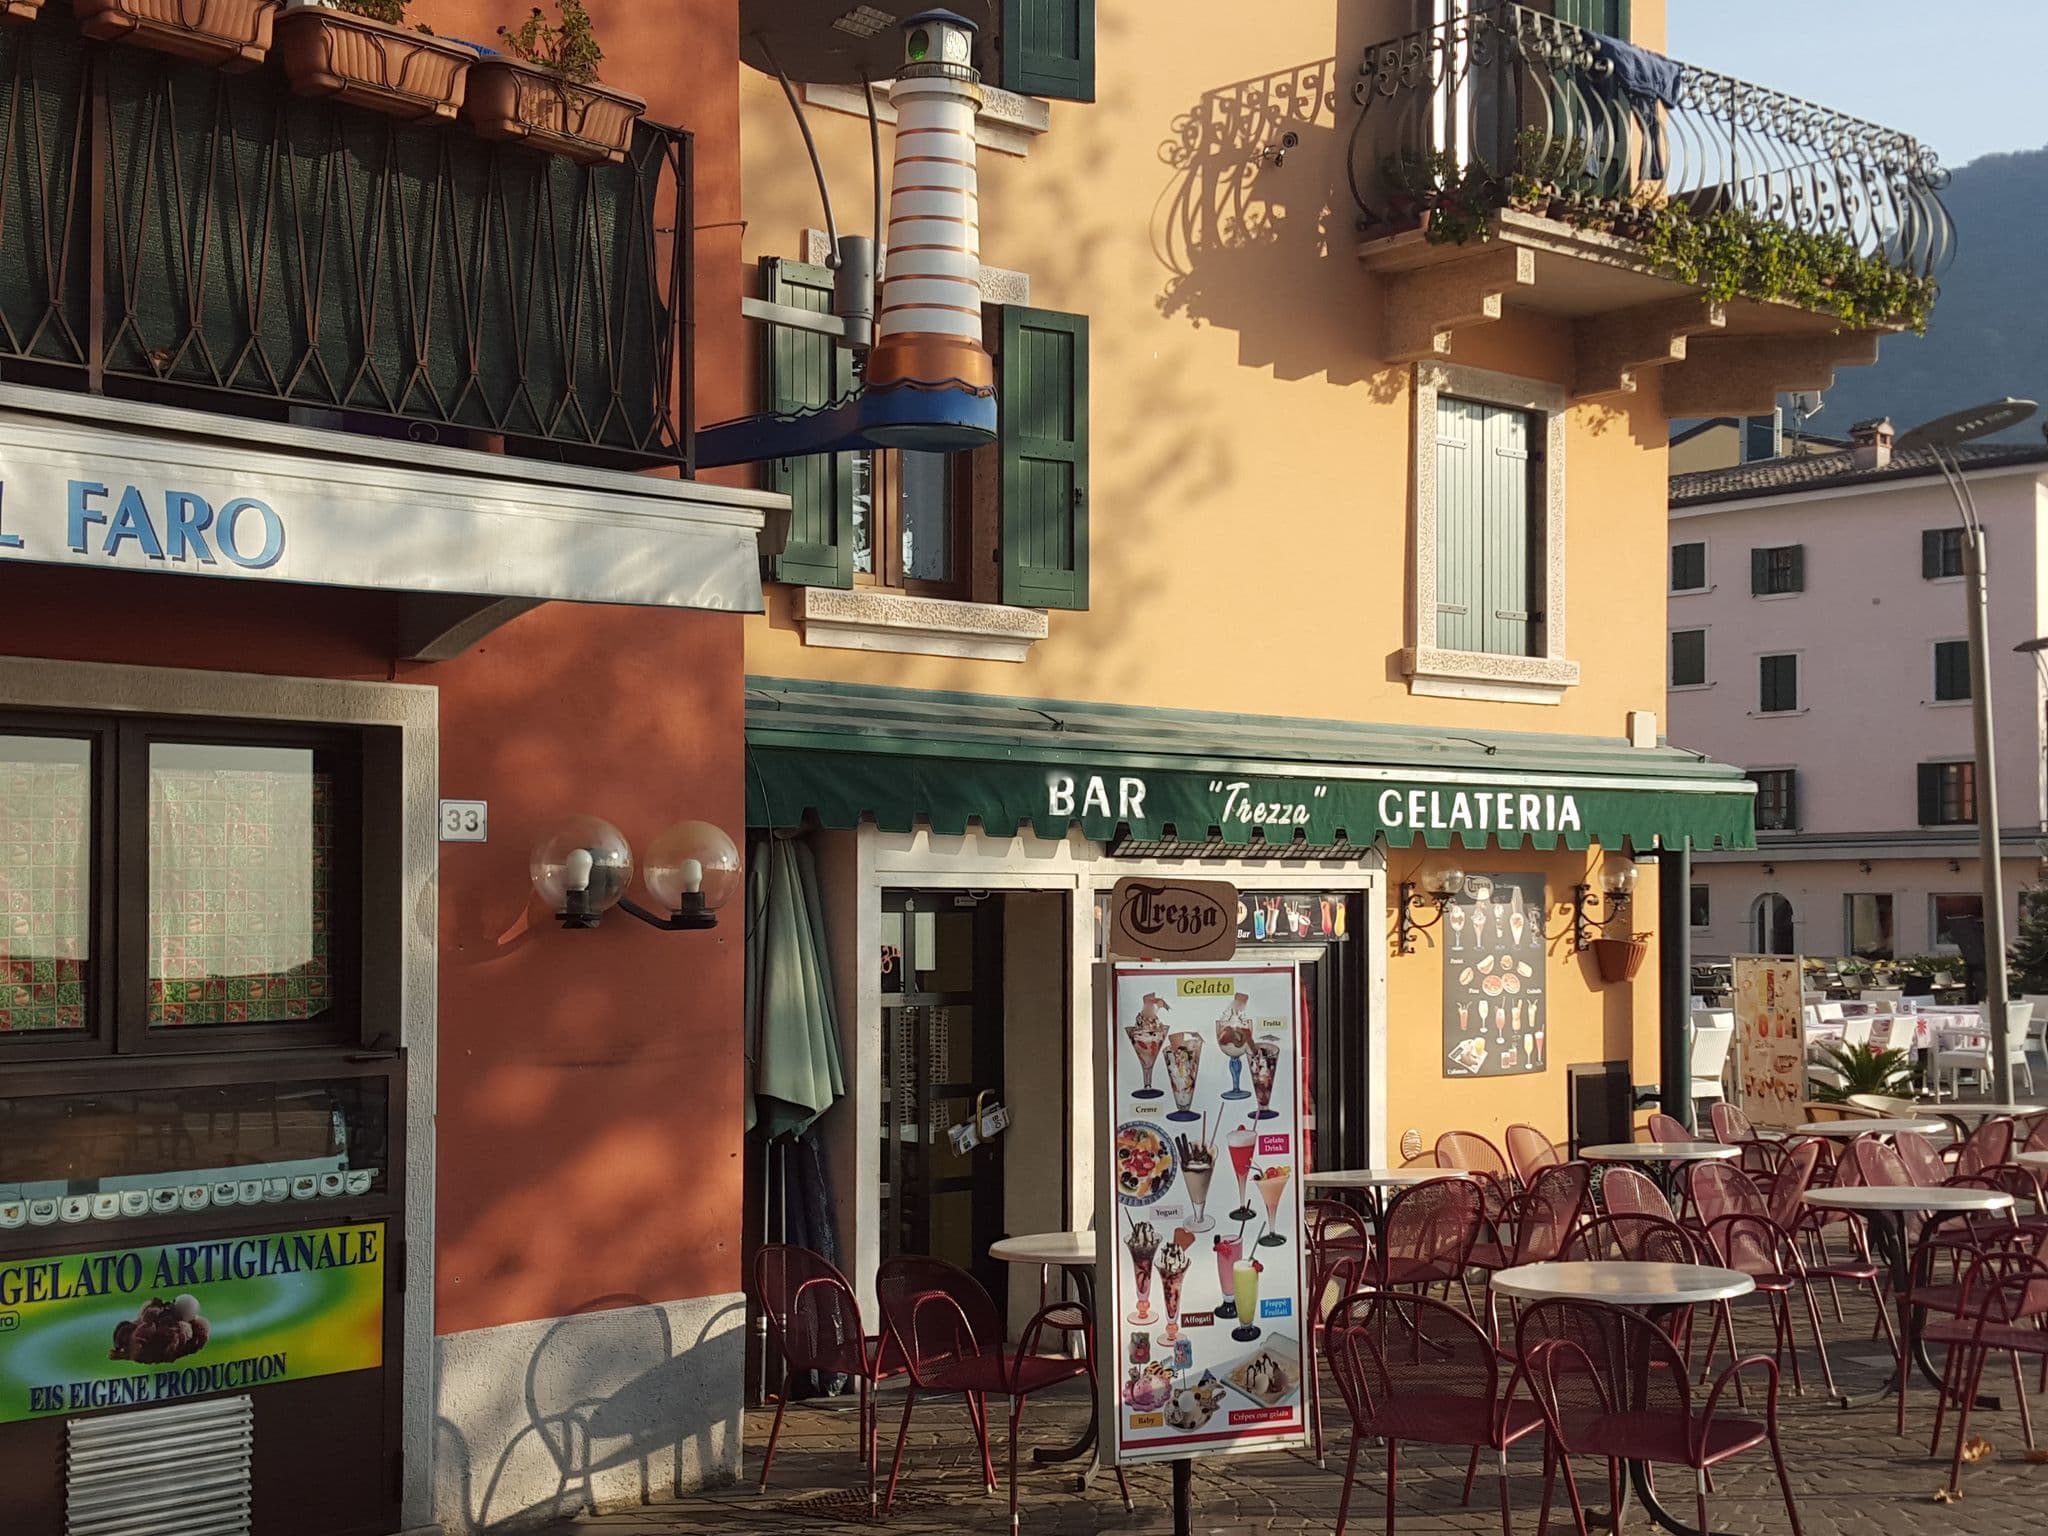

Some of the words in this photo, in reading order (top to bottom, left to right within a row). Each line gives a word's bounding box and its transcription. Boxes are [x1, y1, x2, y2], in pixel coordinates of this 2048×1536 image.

[67, 479, 286, 570] FARO
[446, 809, 479, 832] 33
[1047, 775, 1146, 819] BAR
[1378, 788, 1581, 832] GELATERIA
[1125, 883, 1218, 935] Trezza
[1183, 979, 1231, 994] Gelato
[1155, 1208, 1178, 1218] Yogurt
[0, 1252, 143, 1306] GELATO
[150, 1230, 378, 1289] ARTIGIANALE
[29, 1385, 64, 1412] EIS
[67, 1375, 150, 1410] EIGENE
[152, 1352, 288, 1400] PRODUCTION
